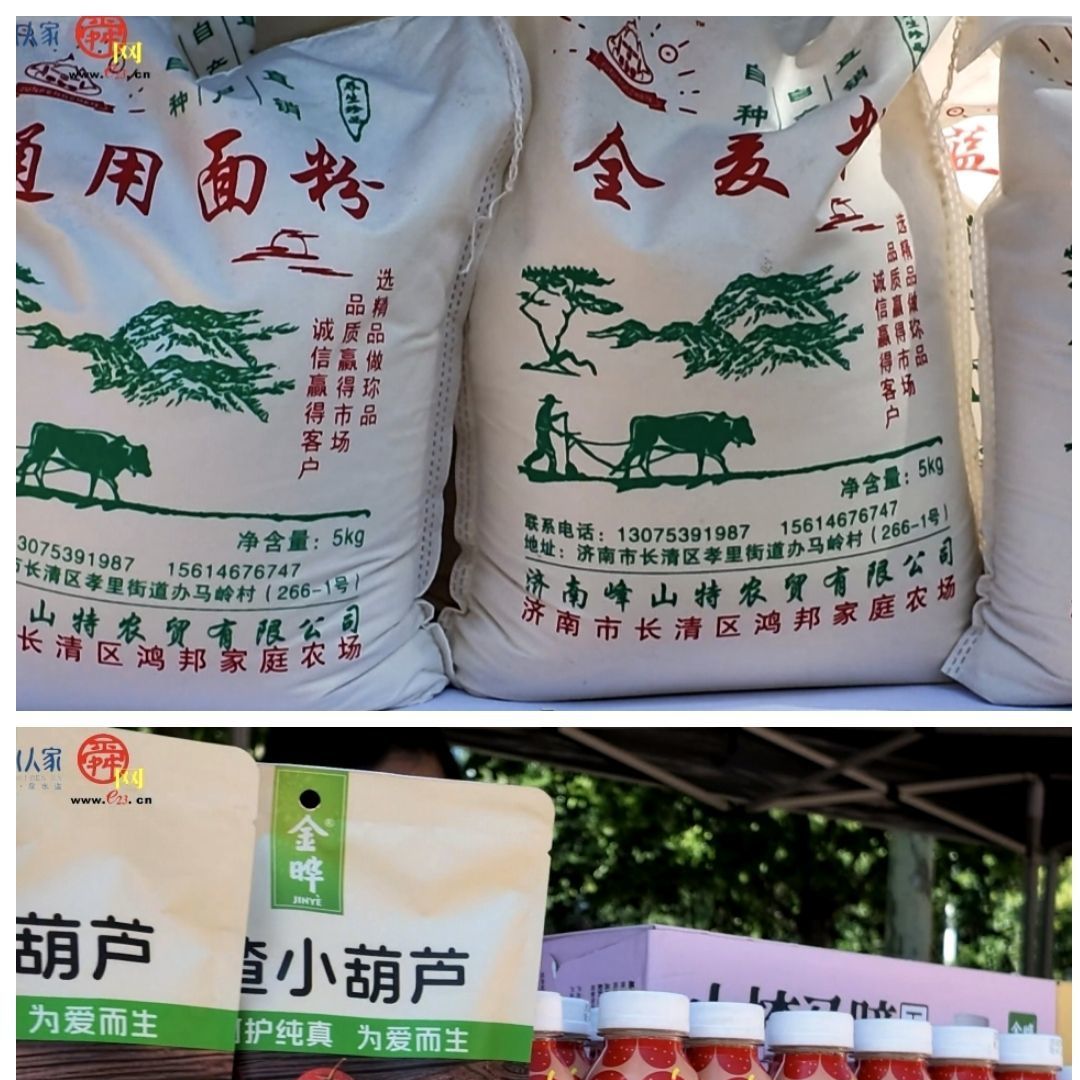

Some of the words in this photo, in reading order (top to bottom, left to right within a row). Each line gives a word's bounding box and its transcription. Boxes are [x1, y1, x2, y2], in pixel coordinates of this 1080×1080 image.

[329, 293, 366, 454] 品质赢得市场
[298, 317, 335, 480] 诚信赢得客户
[780, 500, 899, 536] 15614676747
[167, 560, 302, 579] 15614676747
[524, 537, 954, 612] 济南峰山特农贸有限公司
[521, 572, 956, 642] 济南市长清区鸿邦家庭农场
[17, 626, 362, 673] 长清区鸿邦家庭农场
[28, 1003, 159, 1039] 为爱而生
[356, 1023, 471, 1054] 为爱而生
